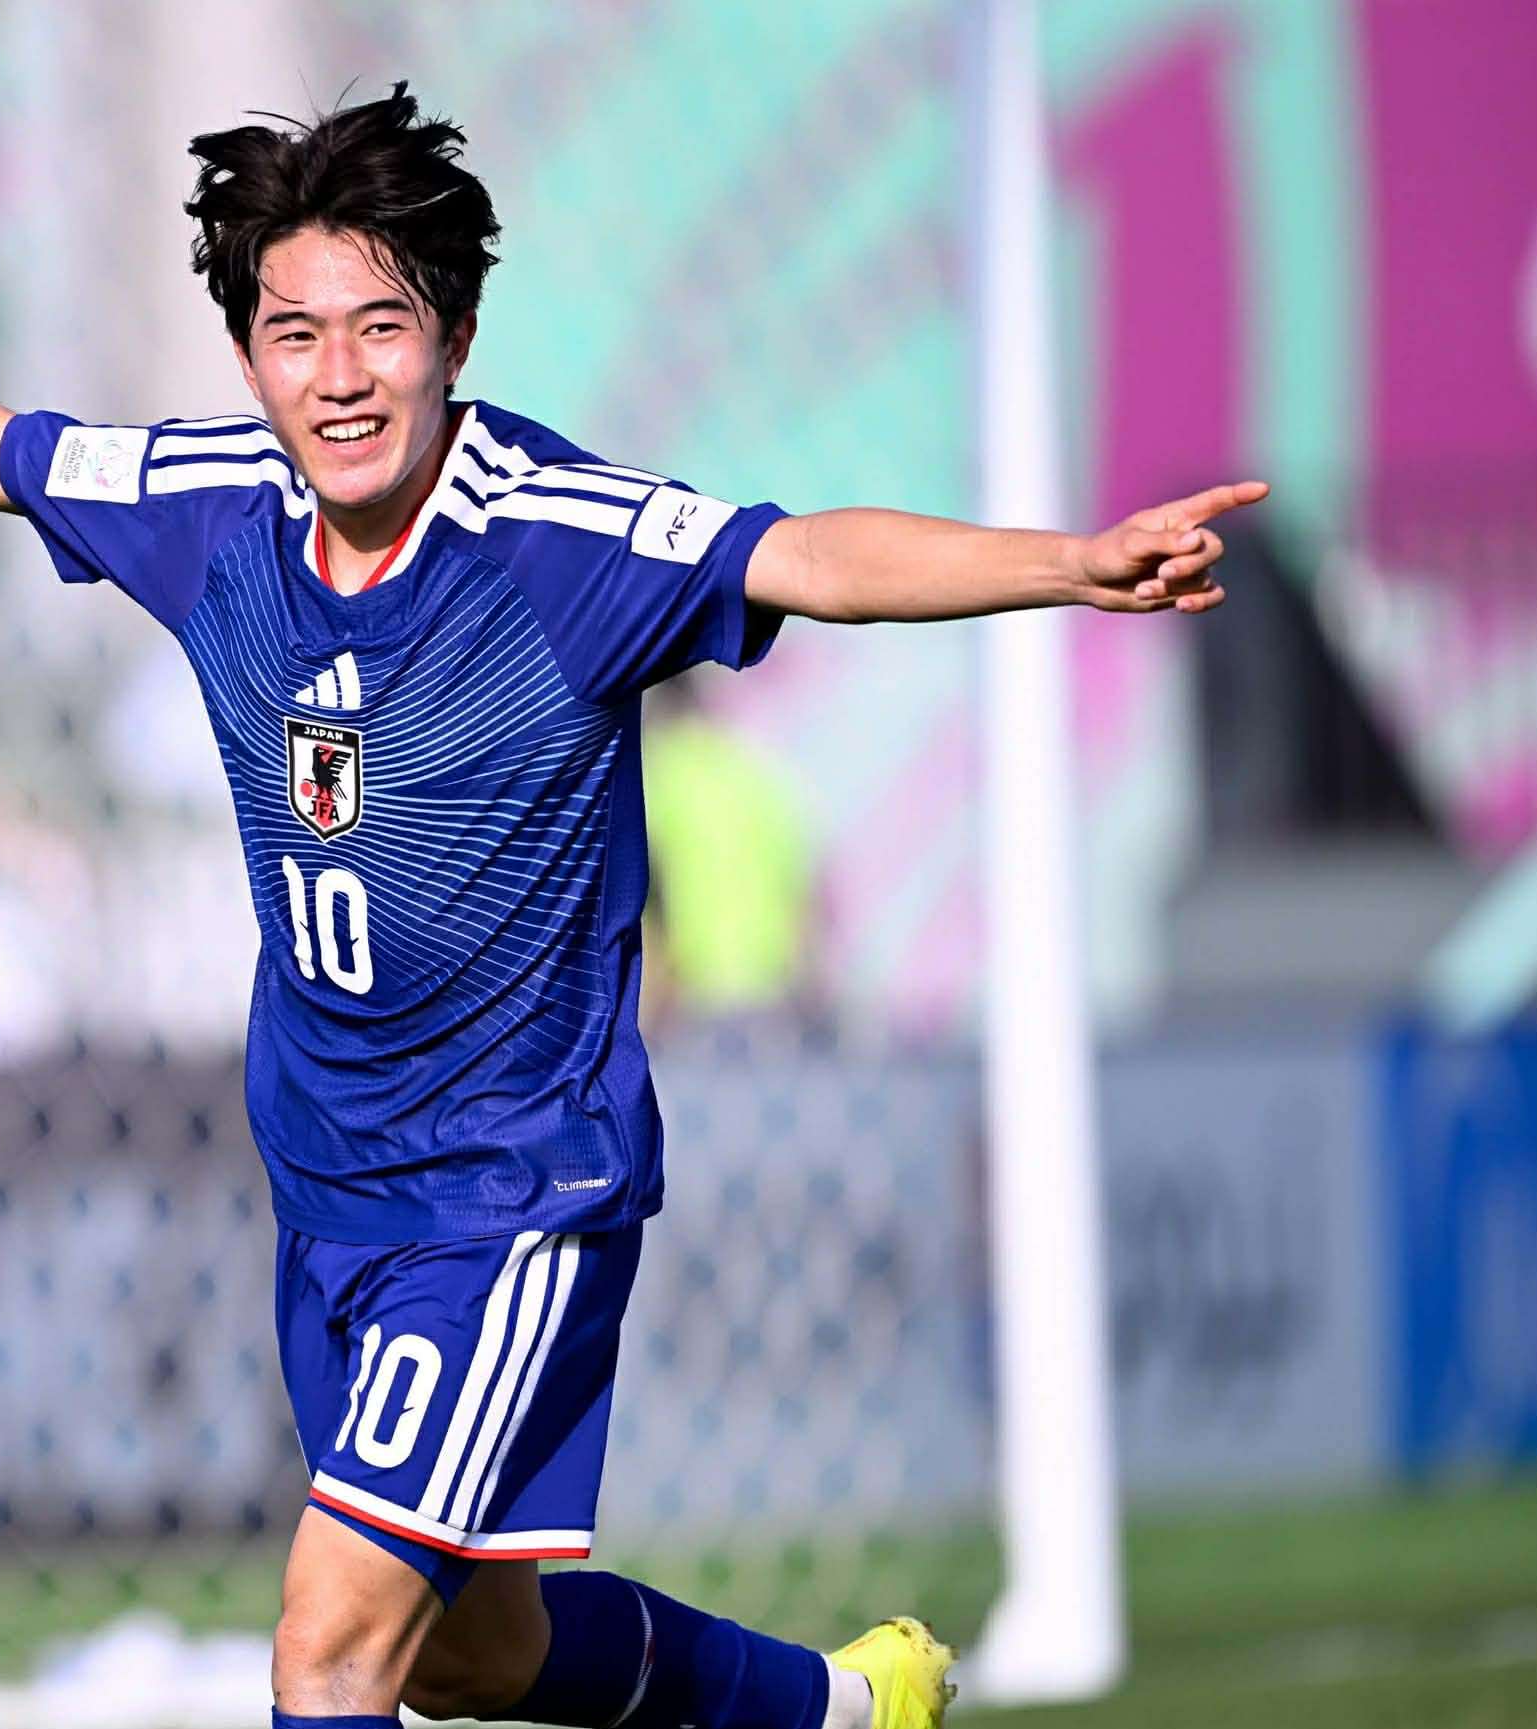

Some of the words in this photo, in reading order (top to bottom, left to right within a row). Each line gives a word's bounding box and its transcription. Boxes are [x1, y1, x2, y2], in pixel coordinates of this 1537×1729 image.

[68, 438, 80, 463] ASIAN
[666, 503, 697, 551] AFC
[304, 726, 343, 741] JAPAN
[308, 800, 340, 822] JFA
[282, 855, 374, 995] 10
[556, 1178, 609, 1192] CLIMACOOL
[335, 1323, 442, 1468] 10
